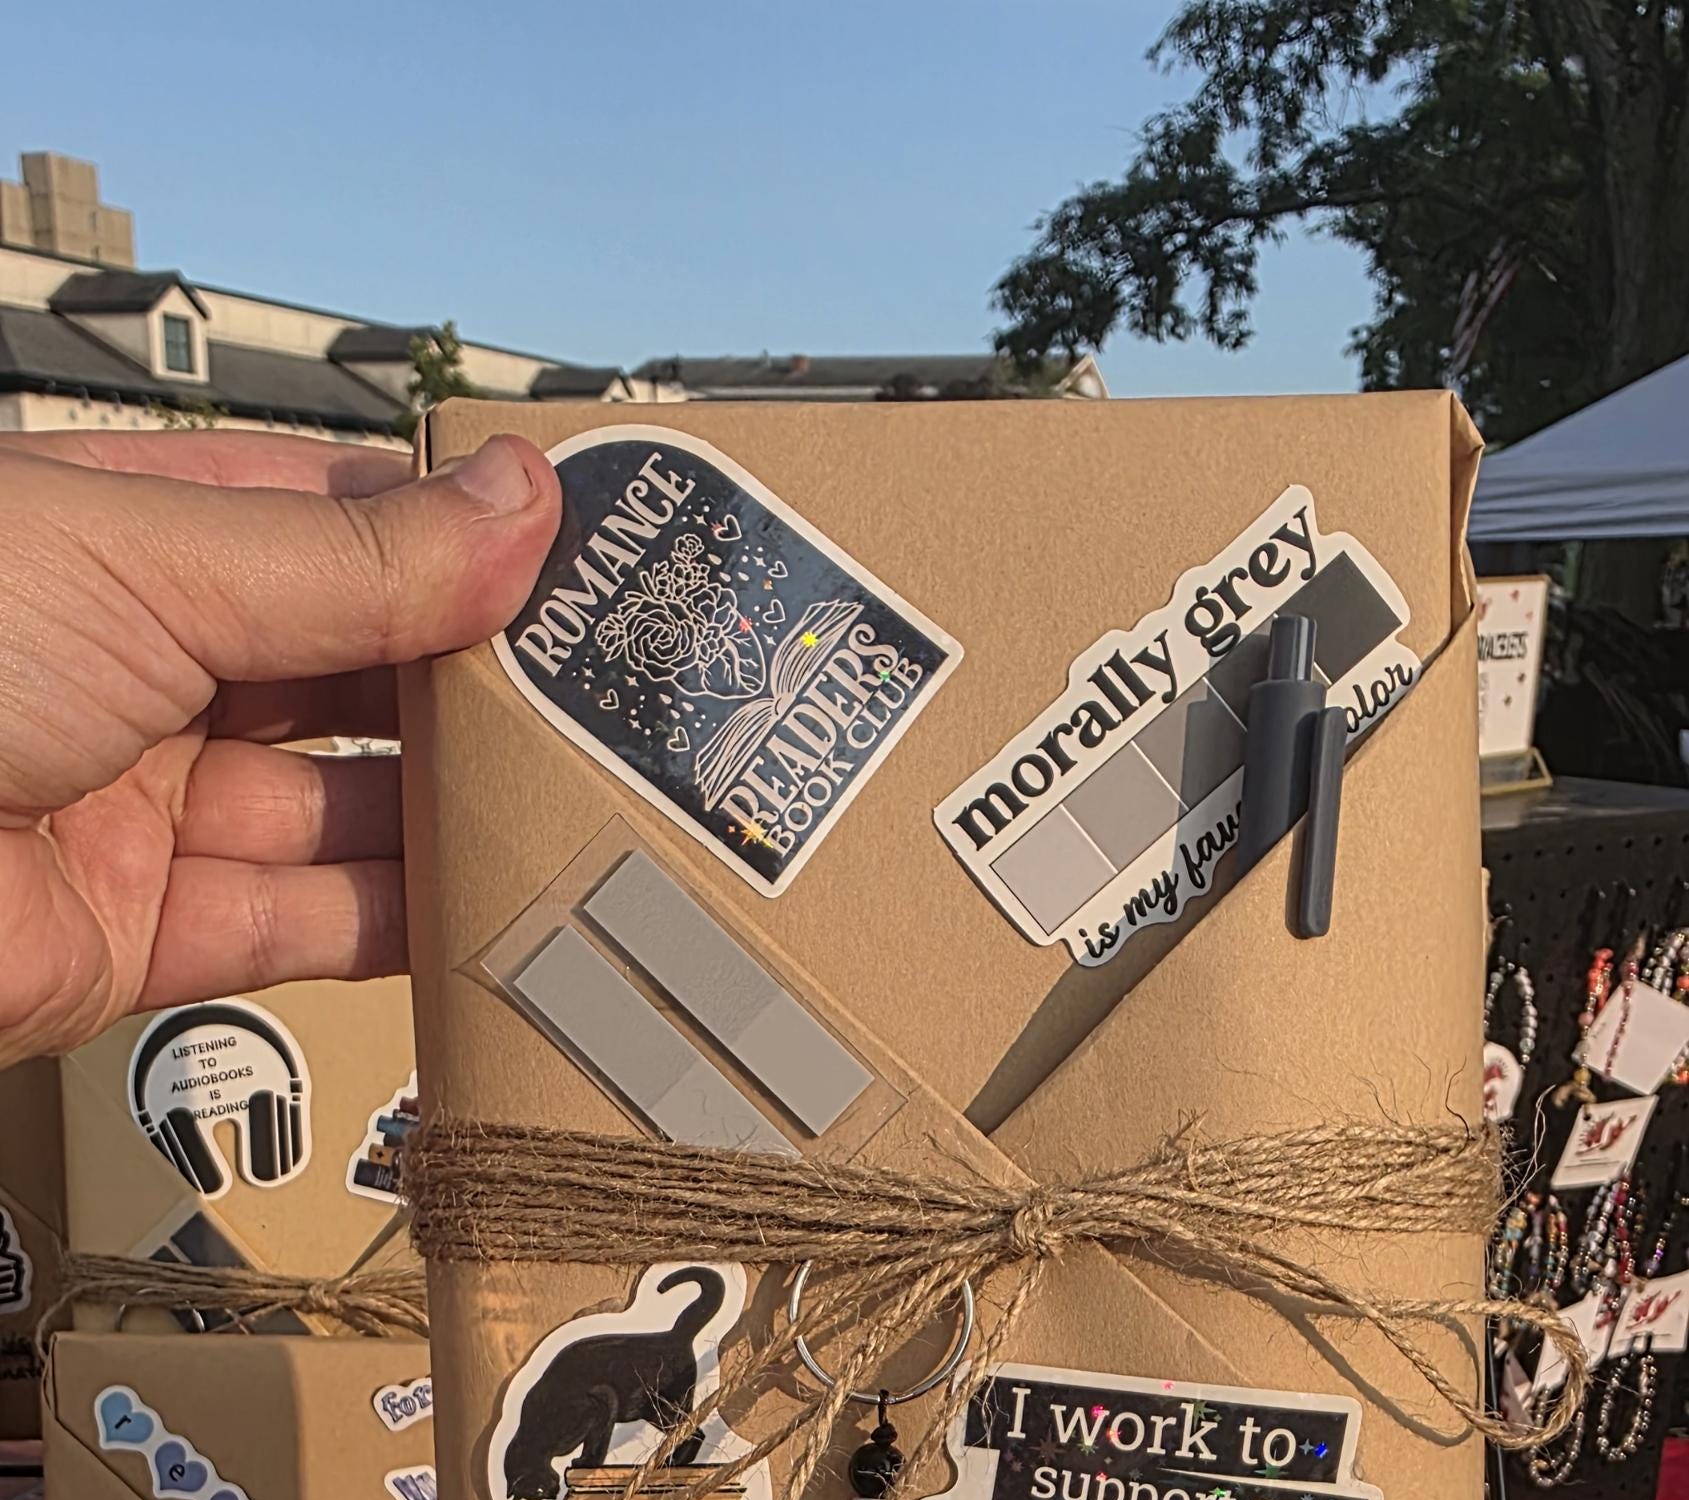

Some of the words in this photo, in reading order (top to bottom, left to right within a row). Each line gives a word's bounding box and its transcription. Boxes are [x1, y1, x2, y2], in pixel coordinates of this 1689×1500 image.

[514, 451, 696, 677] ROMANCE
[951, 629, 1180, 852] morally
[1184, 506, 1318, 657] grey
[719, 622, 901, 827] READERS
[764, 752, 854, 858] BOOK
[846, 656, 924, 751] CLUB
[1078, 922, 1119, 958] is
[1123, 870, 1179, 926] my
[1180, 800, 1241, 888] fav
[1344, 663, 1413, 733] olor
[171, 1065, 254, 1094] AUDIOBOOKS
[172, 1036, 238, 1060] LISTENING
[198, 1057, 217, 1070] TO
[193, 1100, 250, 1121] READING
[209, 1088, 222, 1101] IS
[1006, 1387, 1032, 1440] I
[1050, 1403, 1218, 1462] work
[1240, 1416, 1296, 1467] to
